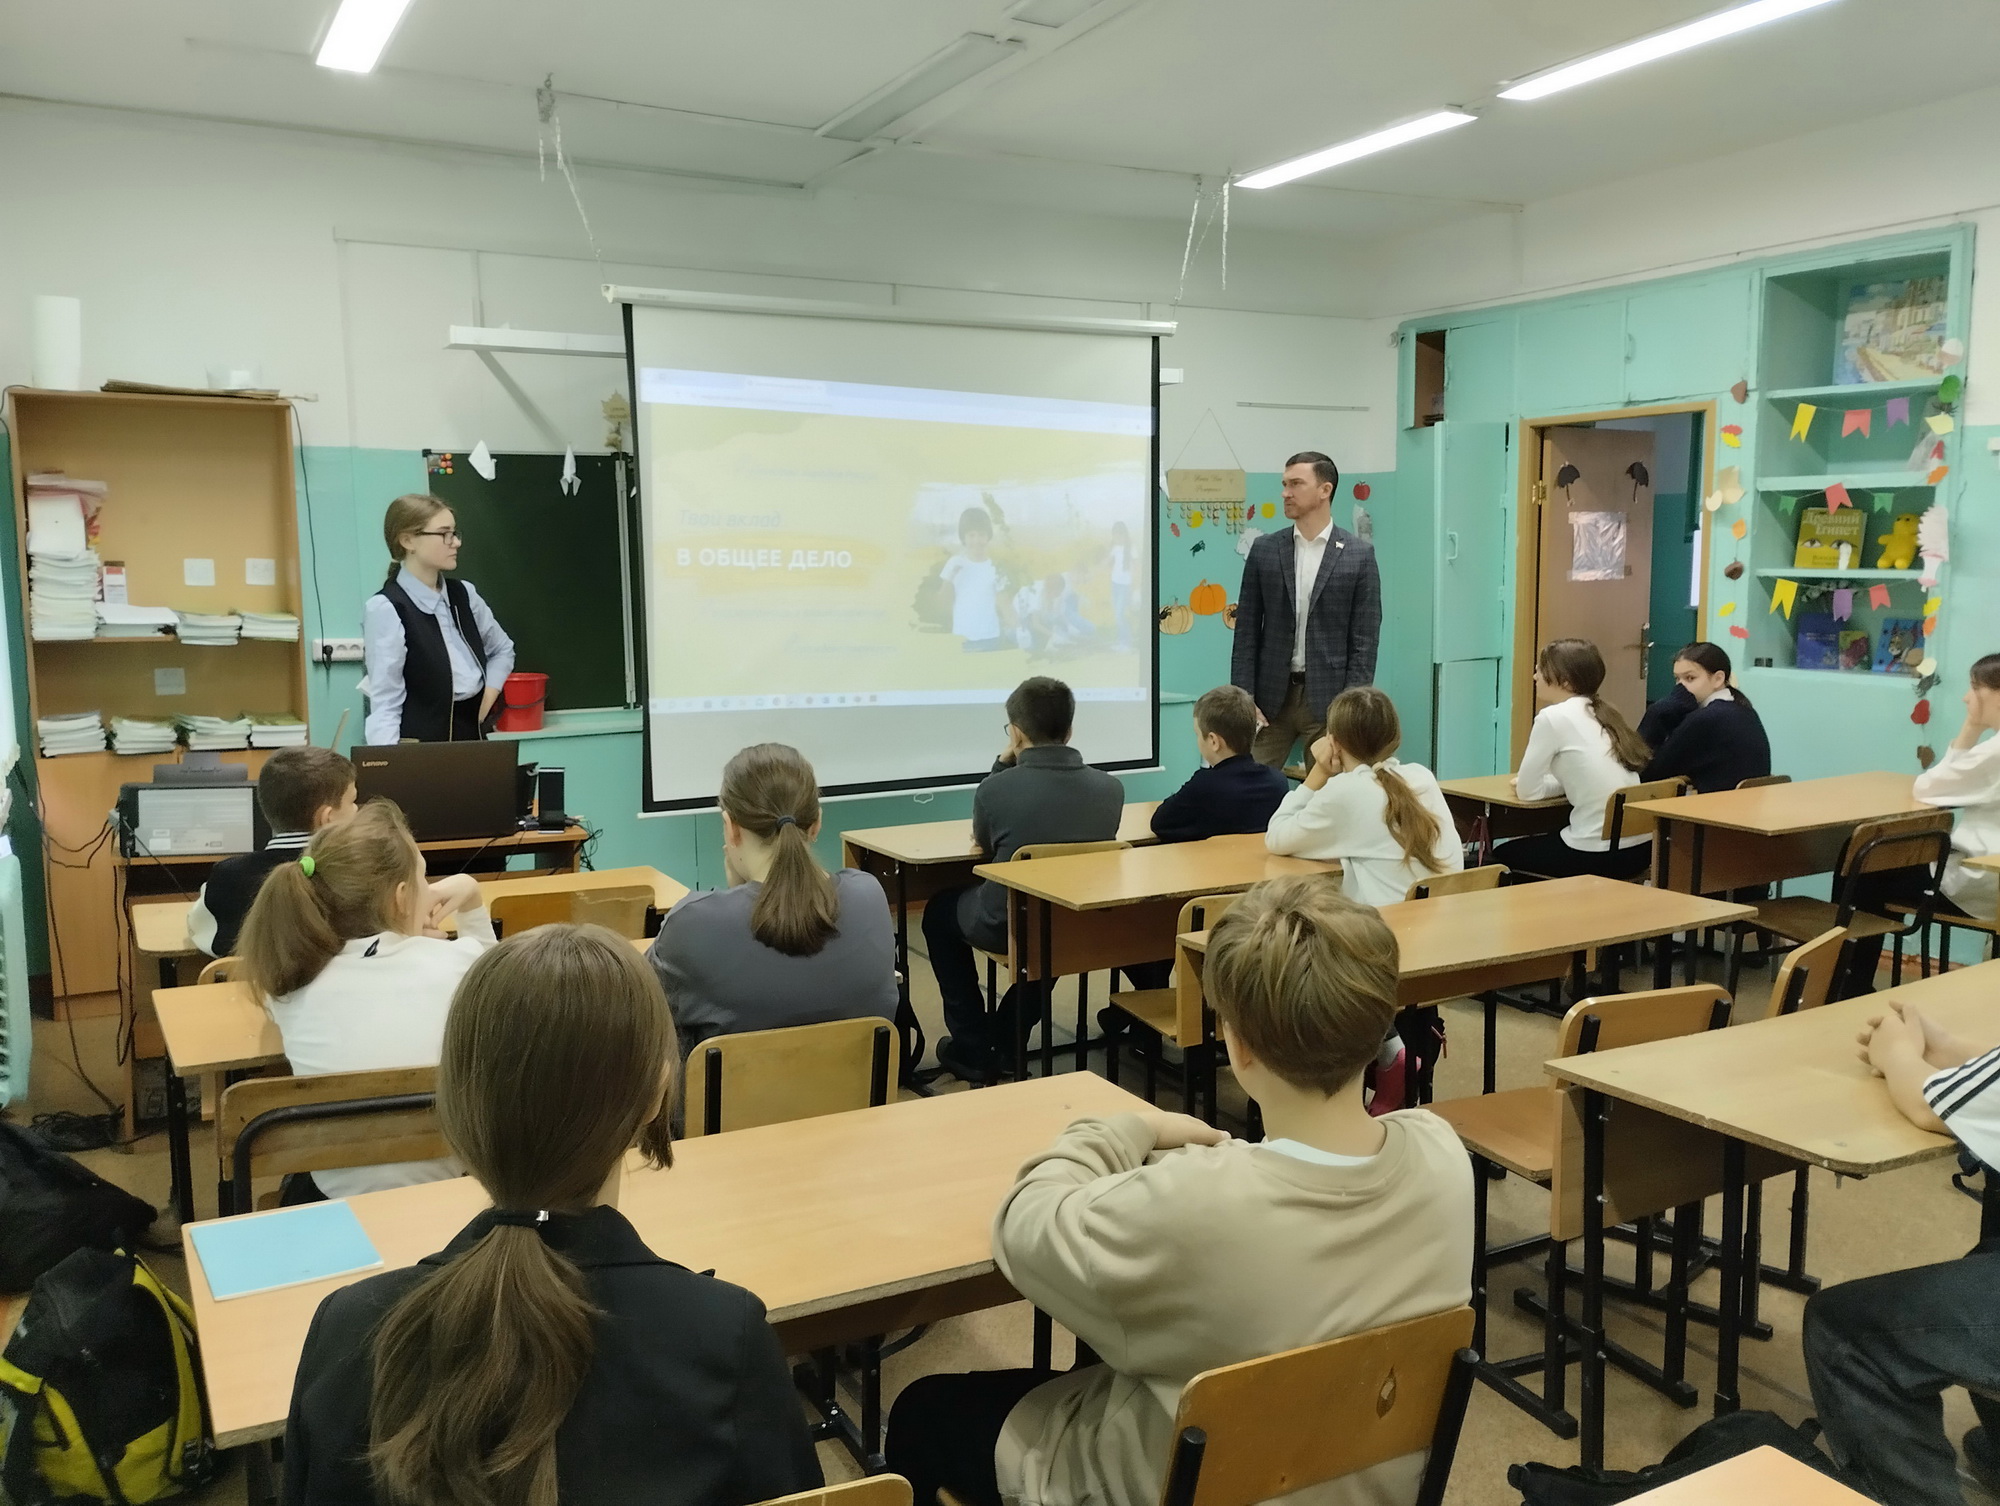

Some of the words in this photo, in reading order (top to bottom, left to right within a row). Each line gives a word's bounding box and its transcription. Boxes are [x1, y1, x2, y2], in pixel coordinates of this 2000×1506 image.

[680, 510, 720, 527] Твой
[726, 511, 782, 528] вклад
[1806, 511, 1860, 525] Древний
[677, 548, 692, 567] В
[699, 548, 782, 570] ОБЩЕЕ
[788, 550, 853, 571] ДЕЛО
[362, 760, 389, 768] Lenovo
